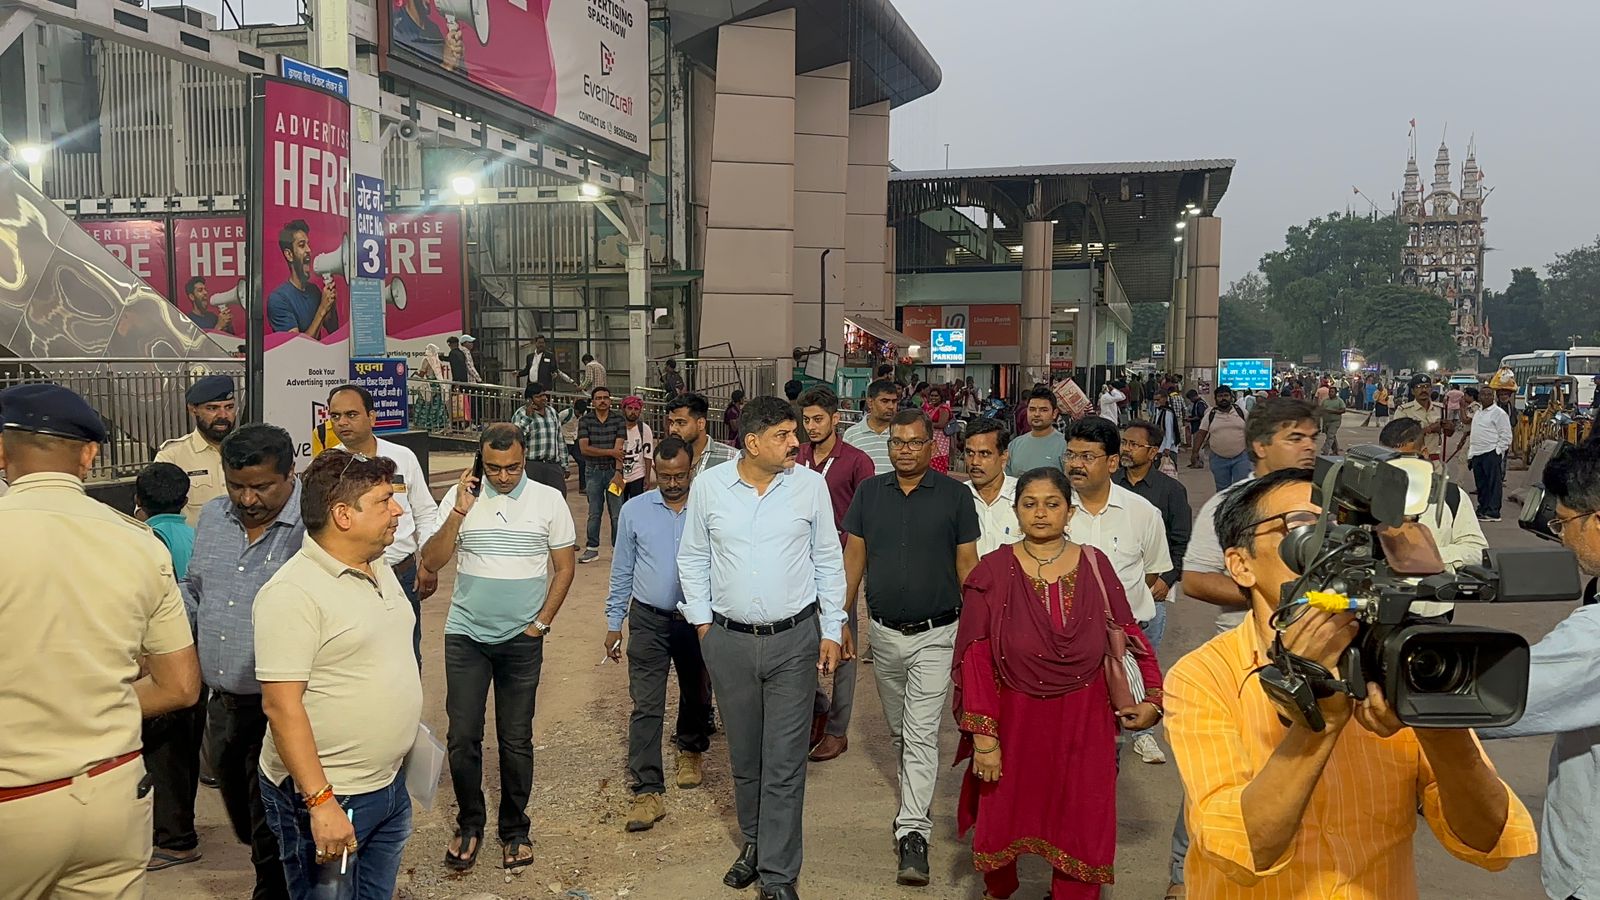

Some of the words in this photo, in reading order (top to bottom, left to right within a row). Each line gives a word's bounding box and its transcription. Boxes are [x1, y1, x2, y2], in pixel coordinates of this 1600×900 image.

[588, 6, 609, 29] SPACE
[610, 20, 626, 39] NOW
[579, 110, 599, 127] CONTACT
[600, 120, 606, 129] US
[357, 180, 372, 211] गेट
[357, 213, 373, 235] GATE
[389, 221, 443, 234] RTISE
[190, 226, 244, 239] ADVER
[363, 239, 380, 274] 3
[933, 353, 963, 361] PARKING
[308, 368, 322, 376] Book
[323, 368, 336, 376] Your
[355, 363, 384, 375] सूचना
[286, 378, 323, 388] Advertising
[325, 379, 339, 387] space
[387, 410, 404, 418] Building
